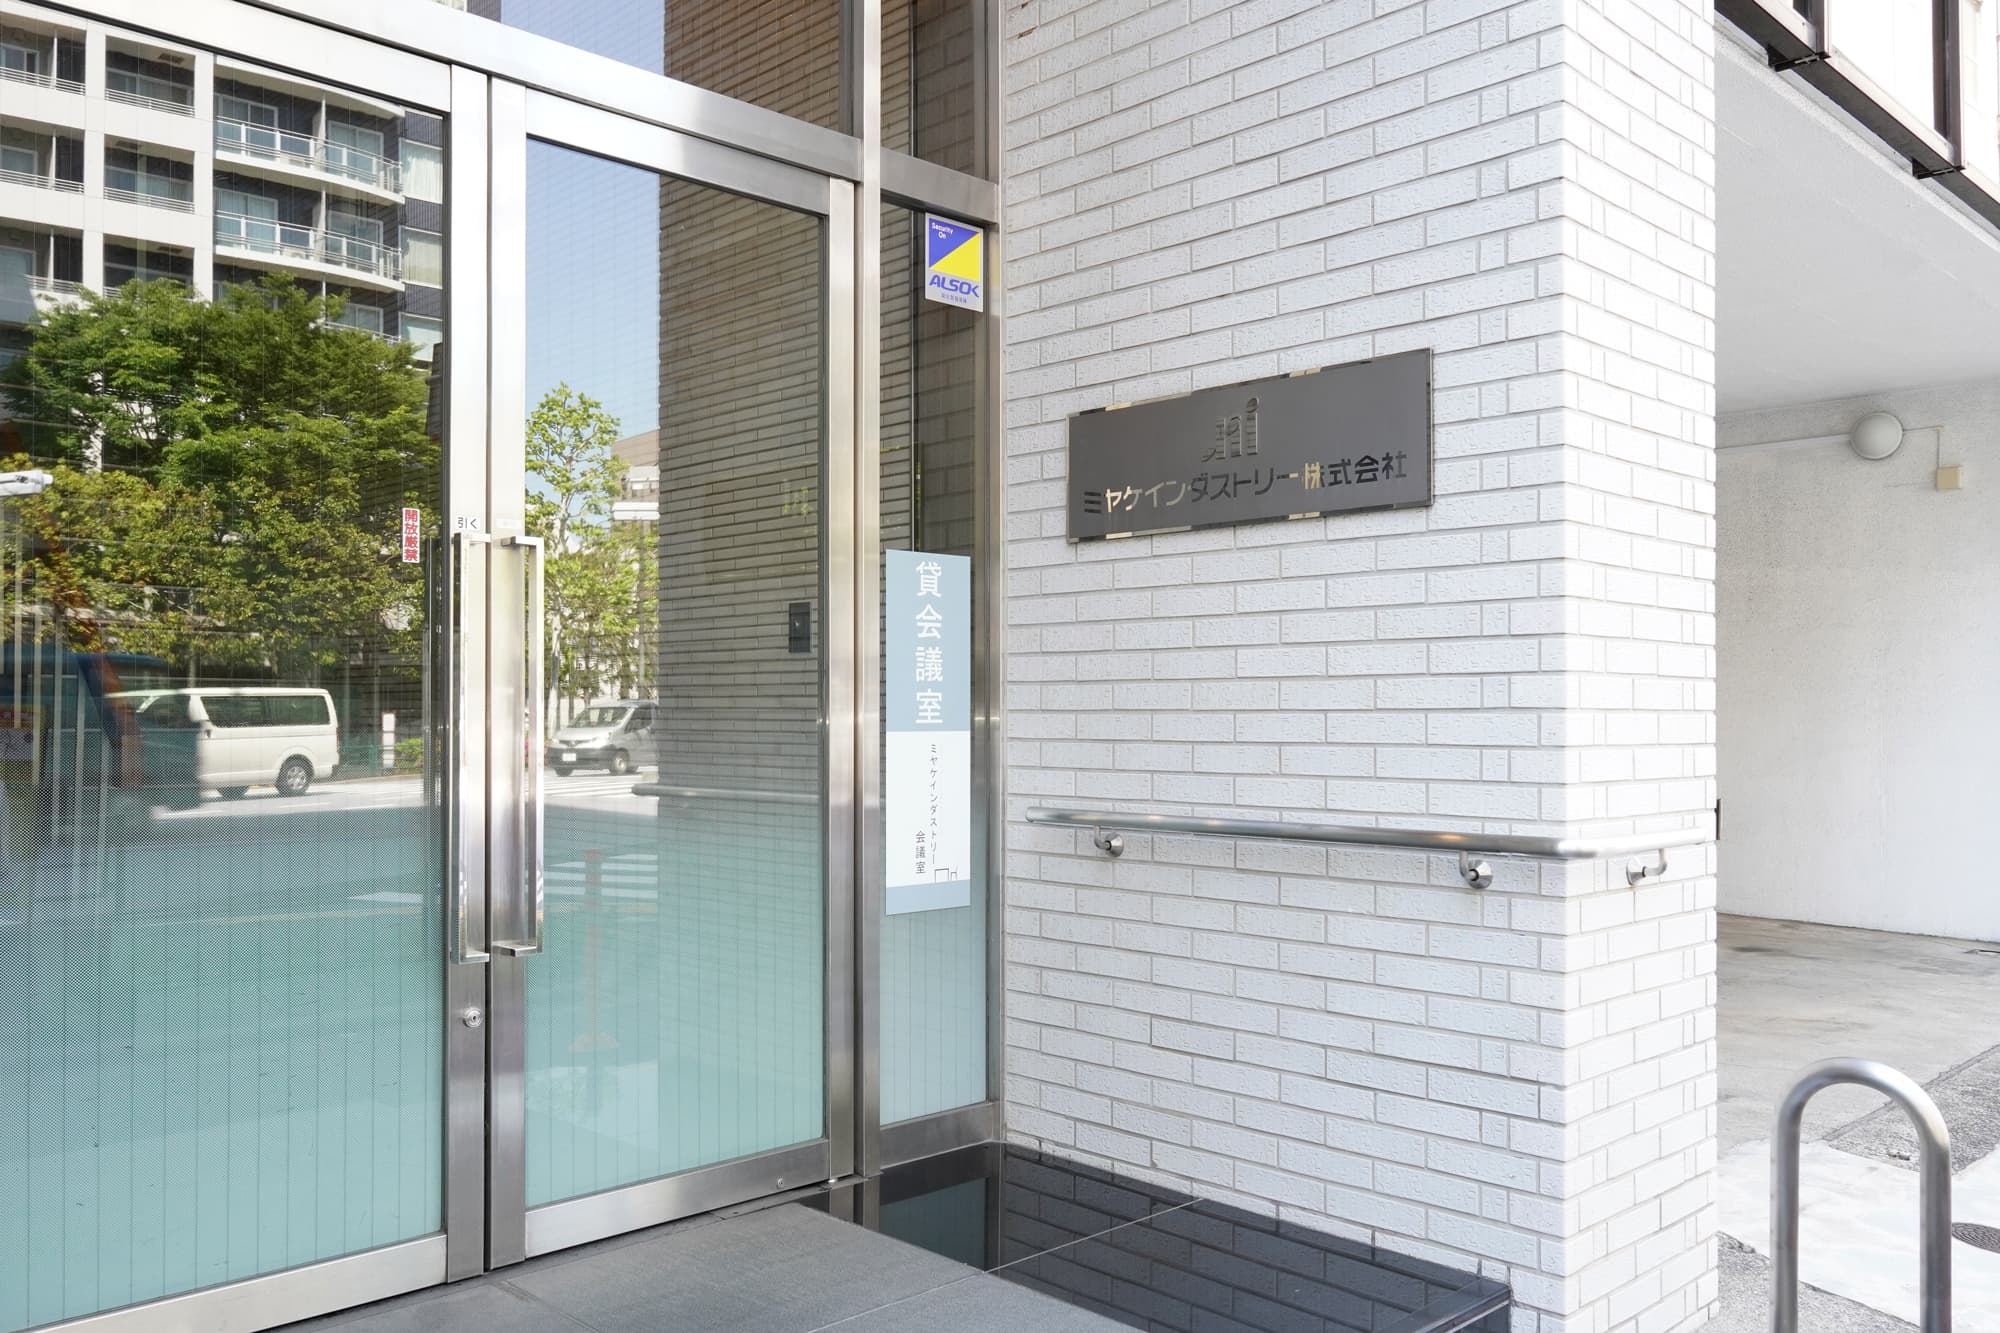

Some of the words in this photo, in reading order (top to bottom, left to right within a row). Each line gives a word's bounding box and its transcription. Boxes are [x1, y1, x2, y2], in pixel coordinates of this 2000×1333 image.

[929, 274, 979, 298] ALSOK
[1084, 451, 1407, 513] ミヤケインダストリー株式会社
[457, 517, 478, 528] 引く
[915, 561, 943, 724] 貸会議室
[929, 744, 938, 865] ミヤケインダストリー
[915, 830, 926, 874] 会議室
